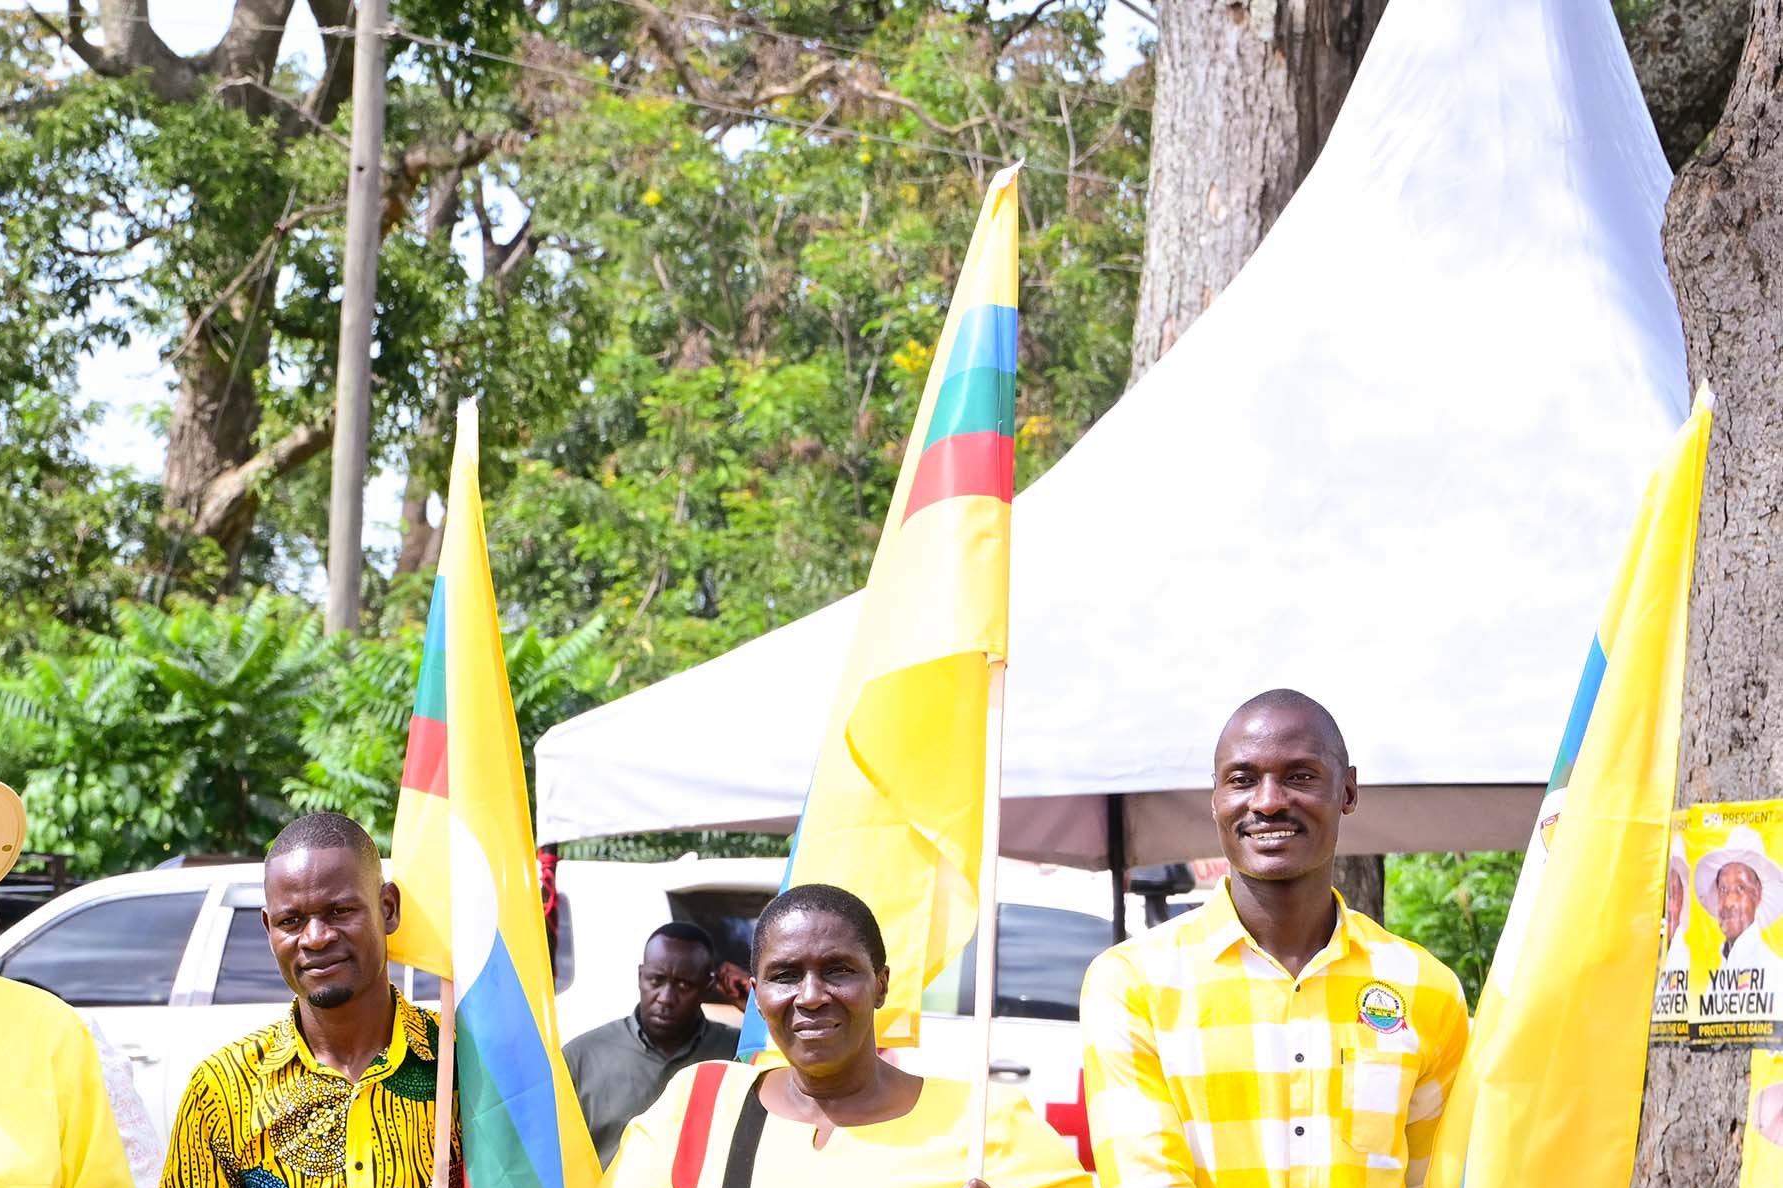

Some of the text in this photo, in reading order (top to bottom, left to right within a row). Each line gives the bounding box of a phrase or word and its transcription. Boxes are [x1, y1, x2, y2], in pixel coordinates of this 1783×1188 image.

[1722, 810, 1774, 825] PRESIDENT
[1709, 968, 1766, 991] YOWERI
[1699, 991, 1775, 1016] MUSEVENI
[1748, 1022, 1774, 1036] GAINS
